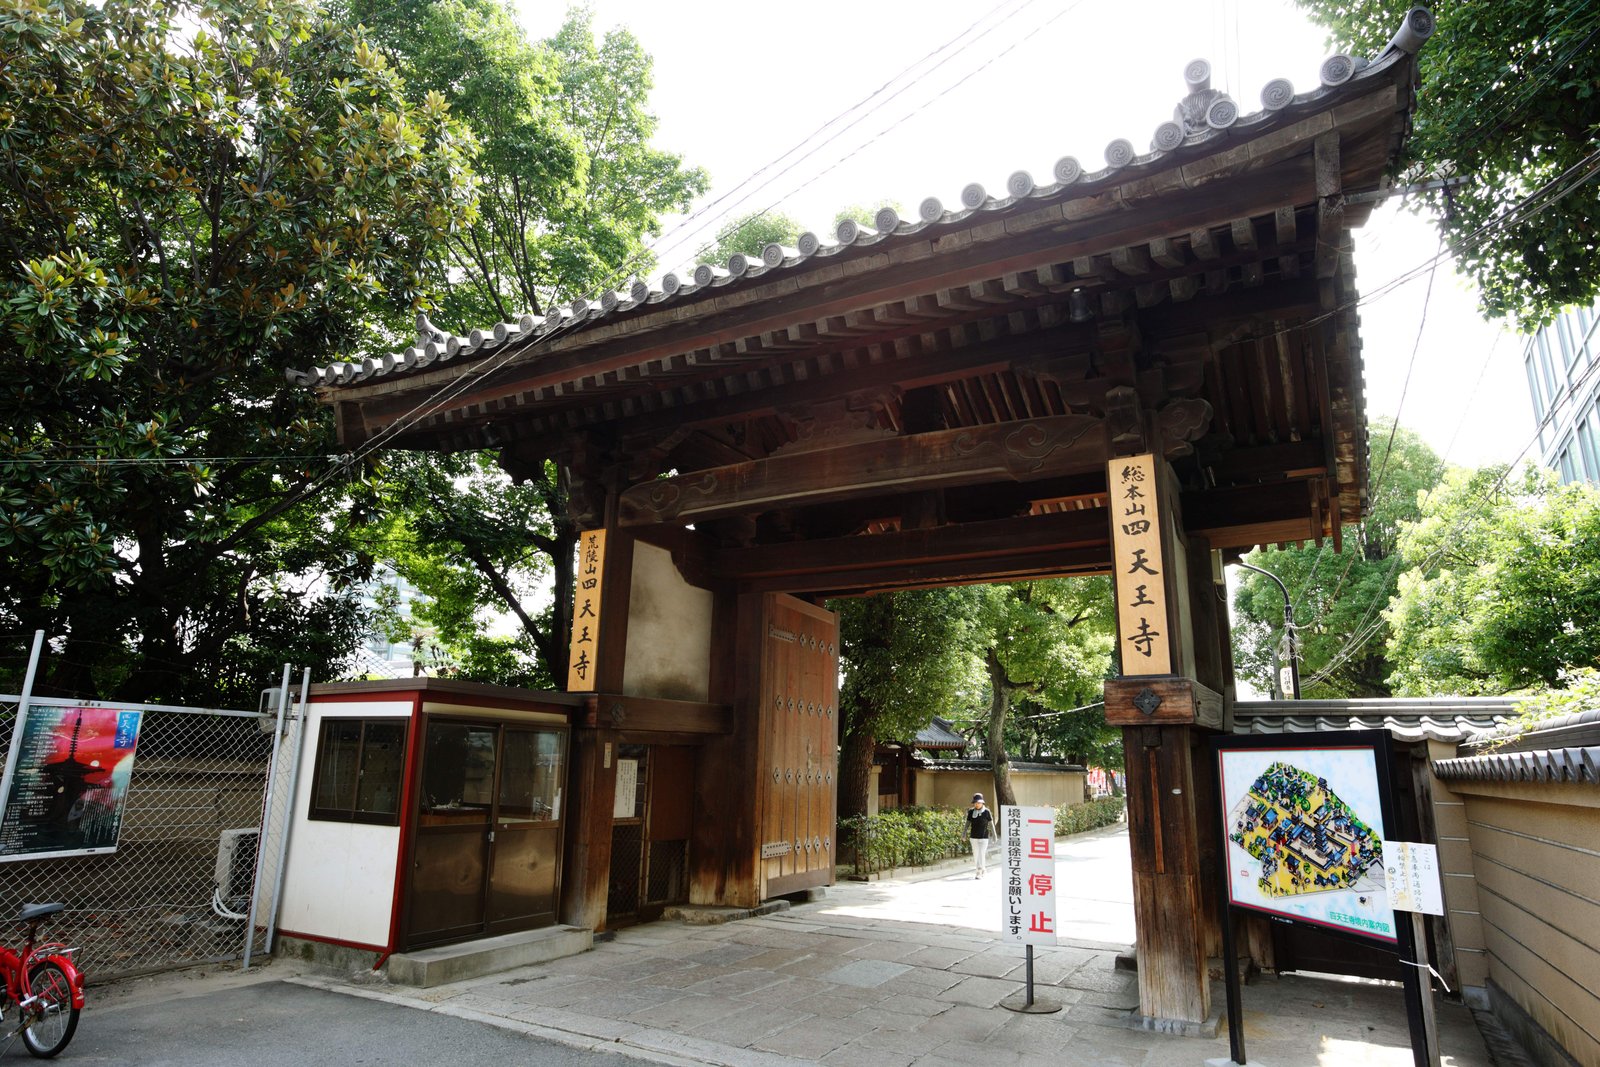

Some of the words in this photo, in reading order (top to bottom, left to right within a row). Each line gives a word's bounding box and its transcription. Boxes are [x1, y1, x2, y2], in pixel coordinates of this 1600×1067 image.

[573, 536, 599, 681] 荒陵山四天王寺
[1121, 465, 1160, 658] 総本山四天王寺
[1007, 808, 1022, 941] 境内は最徐行でお願いします。
[1027, 819, 1054, 934] 一旦停止
